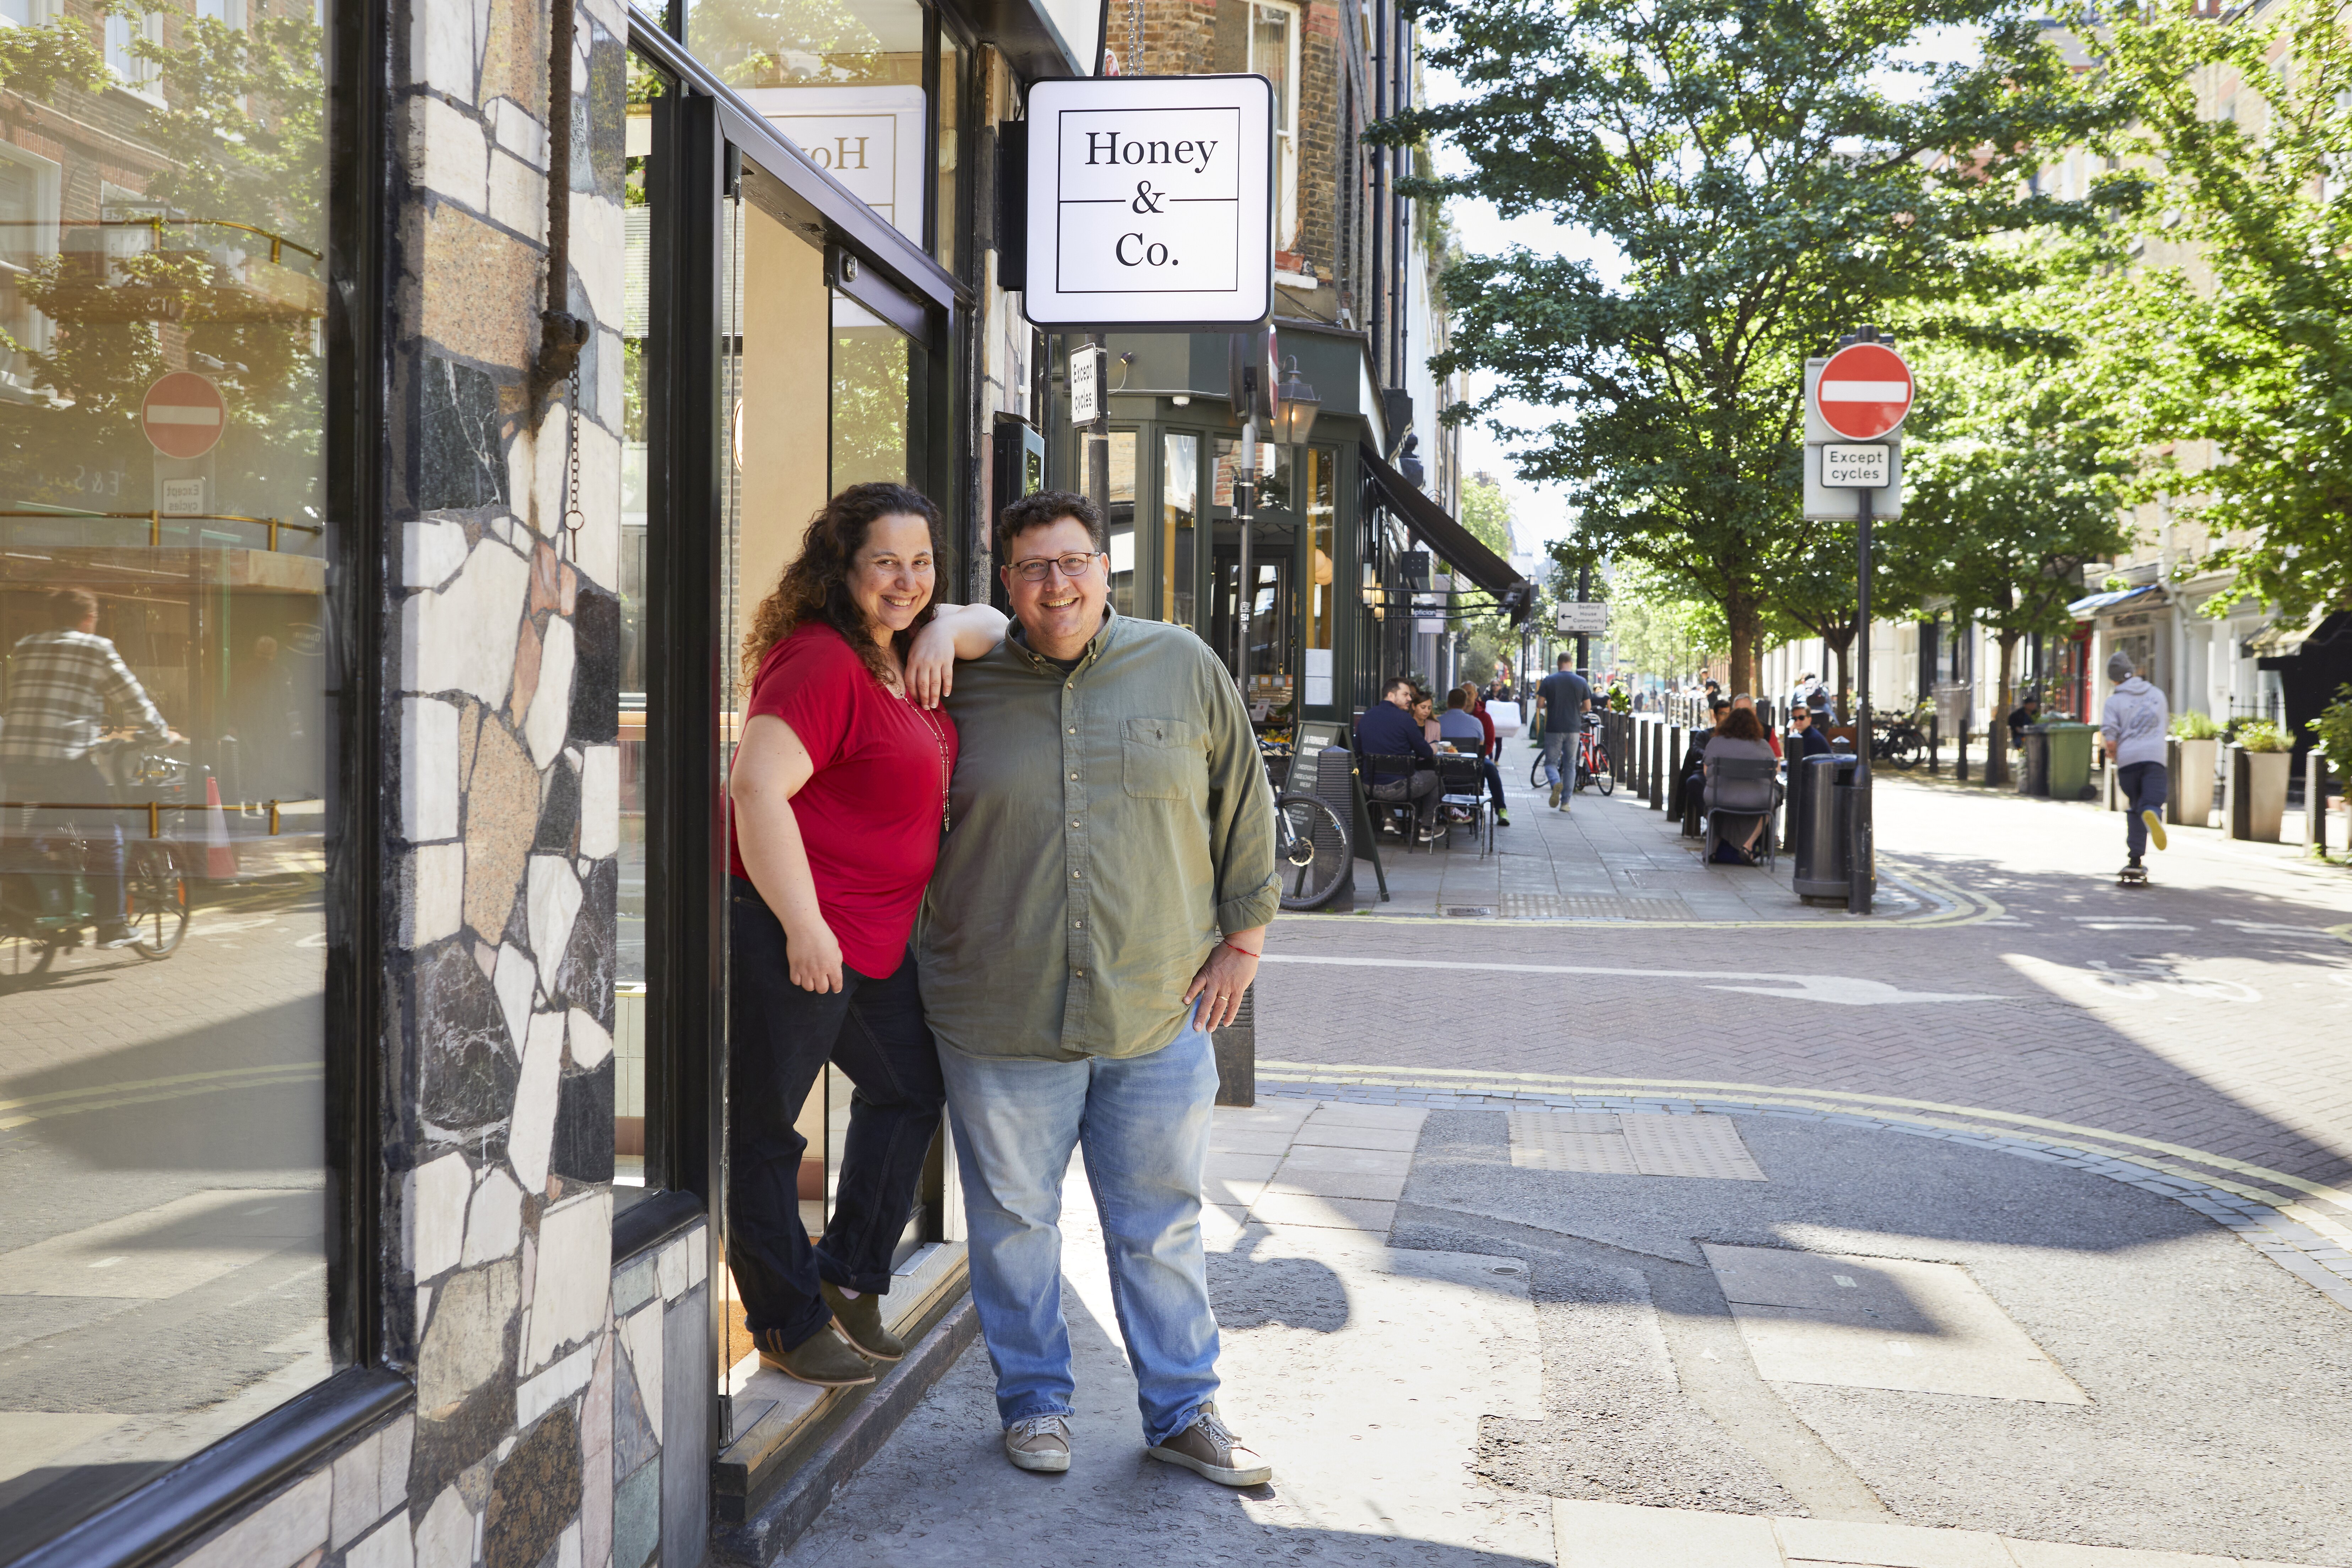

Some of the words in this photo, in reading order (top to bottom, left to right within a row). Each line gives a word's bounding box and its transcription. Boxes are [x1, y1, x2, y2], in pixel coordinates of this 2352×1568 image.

[1085, 131, 1218, 174] Honey
[1132, 180, 1165, 214] &
[1116, 233, 1178, 267] Co.
[1074, 359, 1092, 384] Except
[1075, 389, 1092, 414] cycles
[1830, 451, 1882, 465] Except
[1832, 467, 1879, 481] cycles
